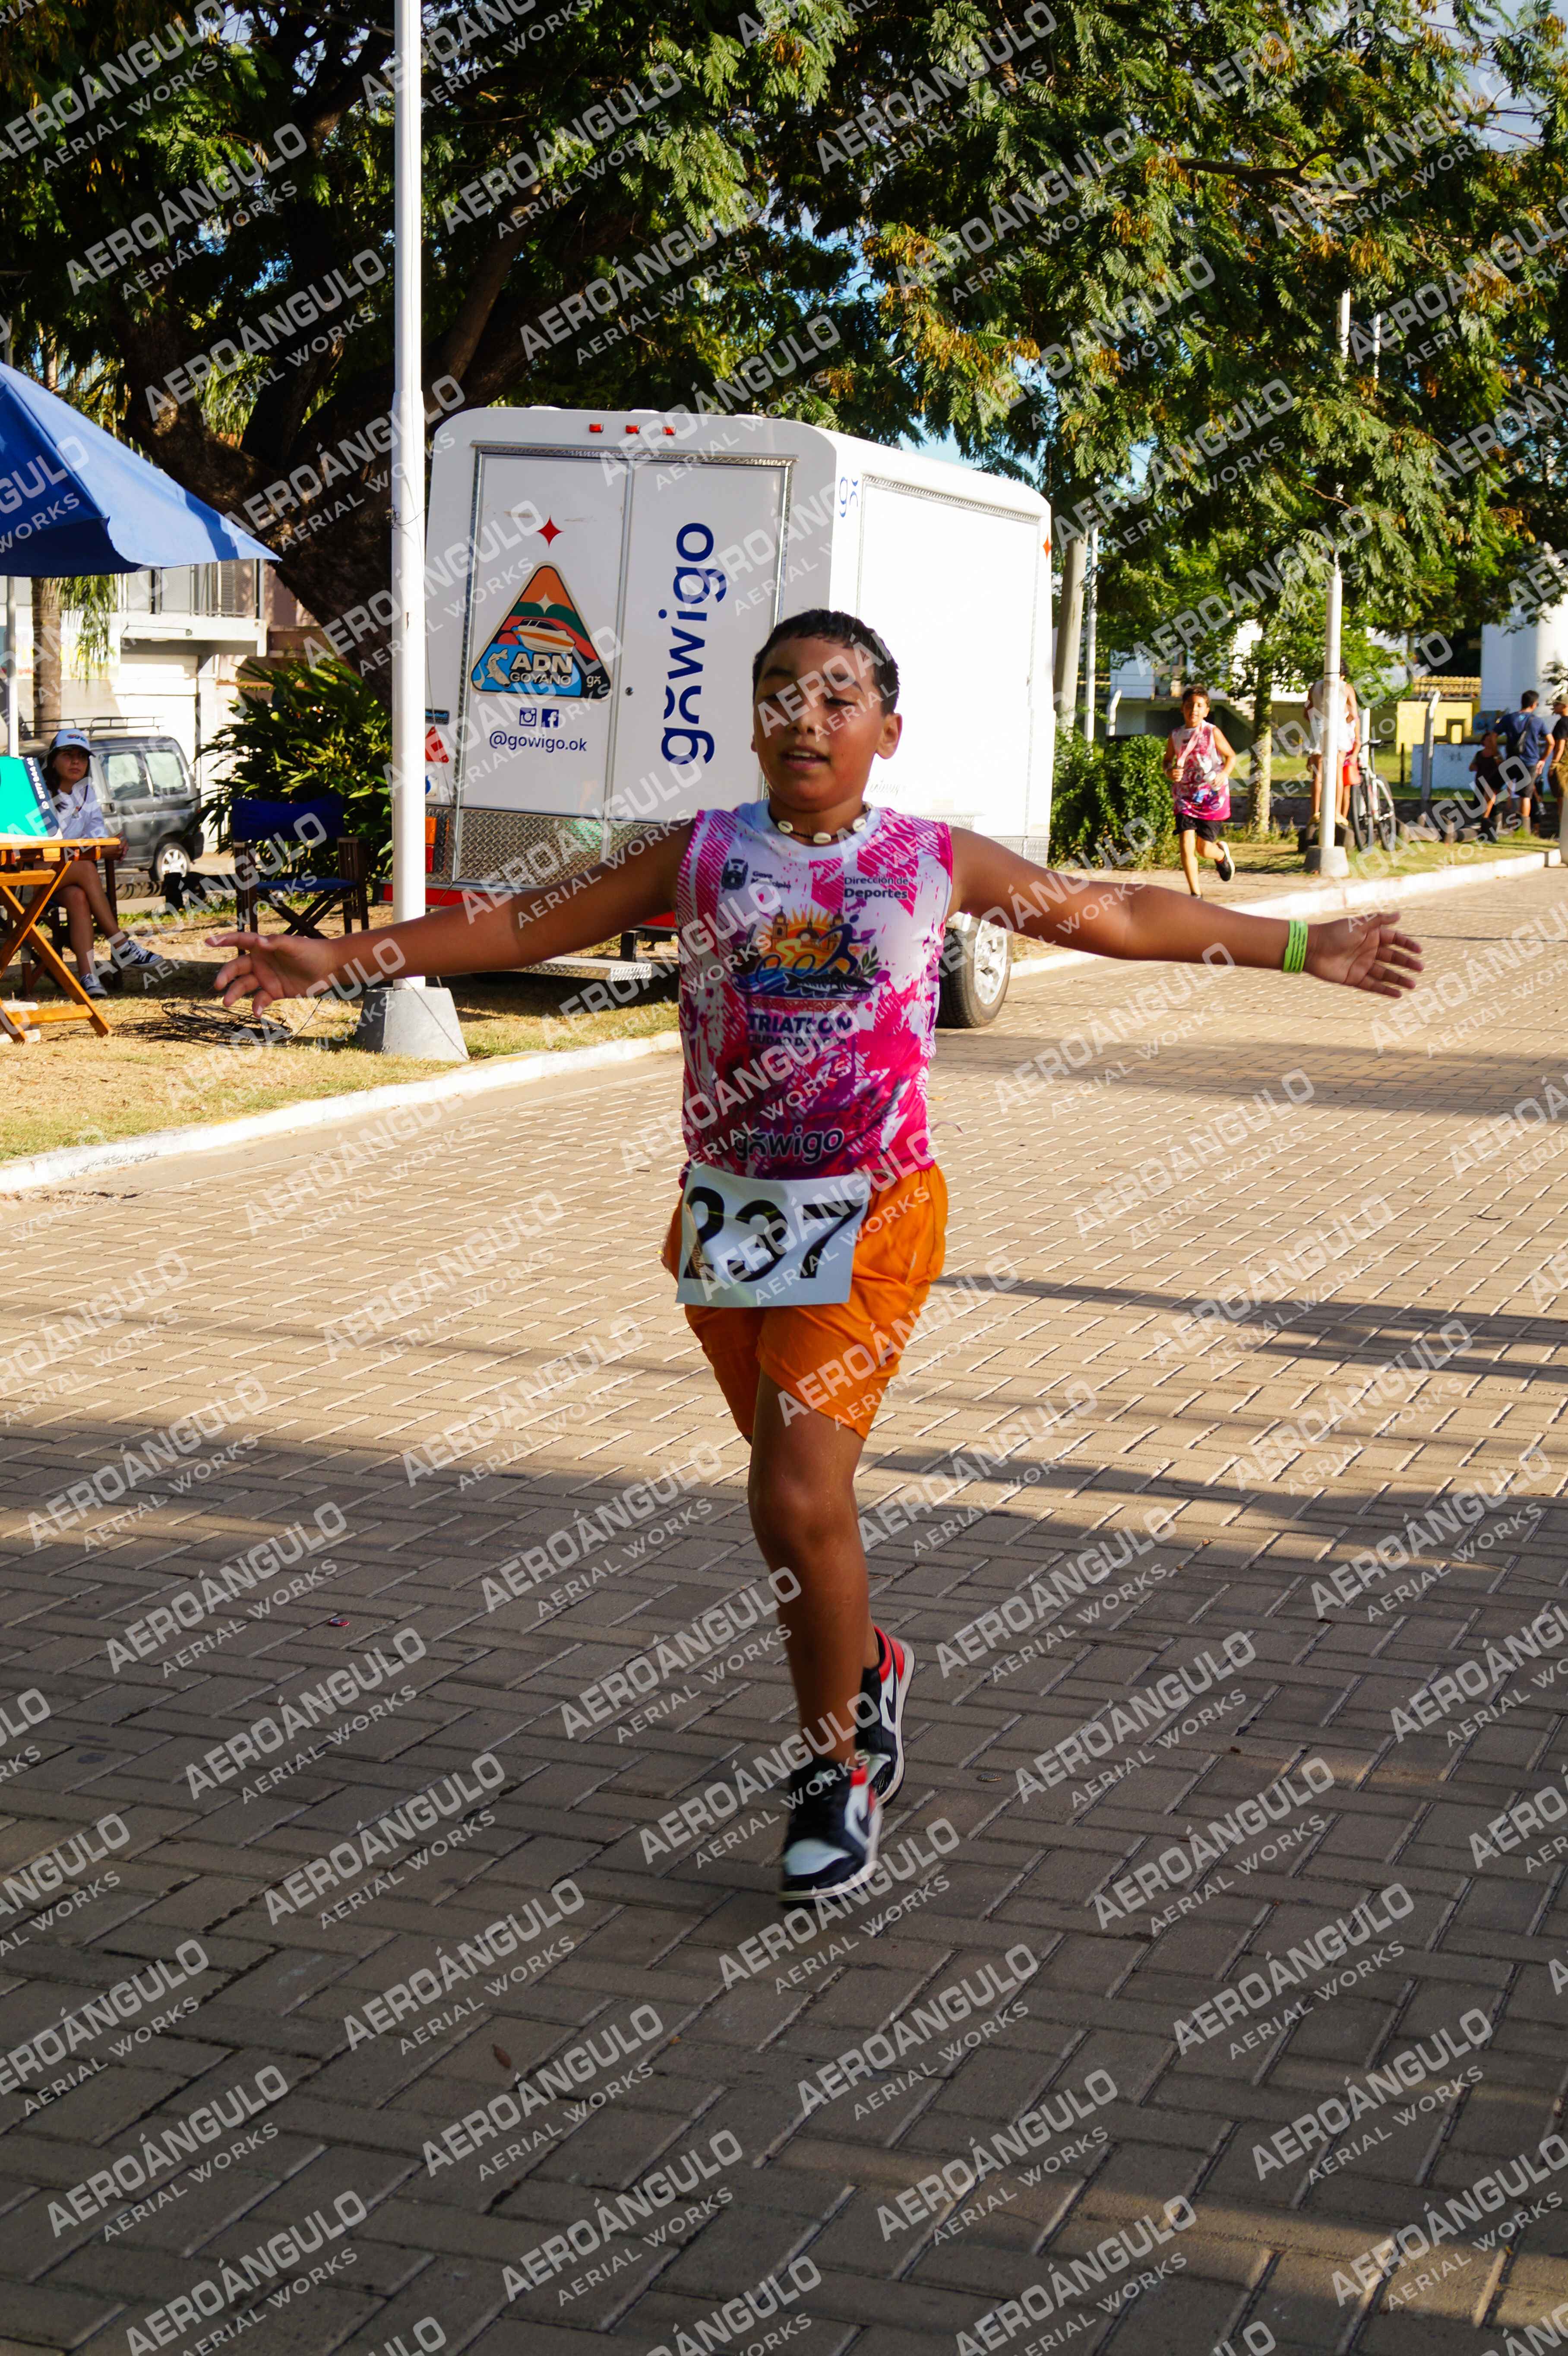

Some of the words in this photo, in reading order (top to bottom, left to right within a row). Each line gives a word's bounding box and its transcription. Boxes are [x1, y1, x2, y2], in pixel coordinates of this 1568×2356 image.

[510, 653, 573, 673] ADN
[510, 672, 572, 685] GOYANO
[490, 731, 588, 753] @gowigo.ok
[844, 876, 894, 885] Dirección
[896, 877, 908, 885] de
[844, 888, 908, 900] Deportes
[683, 1186, 867, 1282] 237
